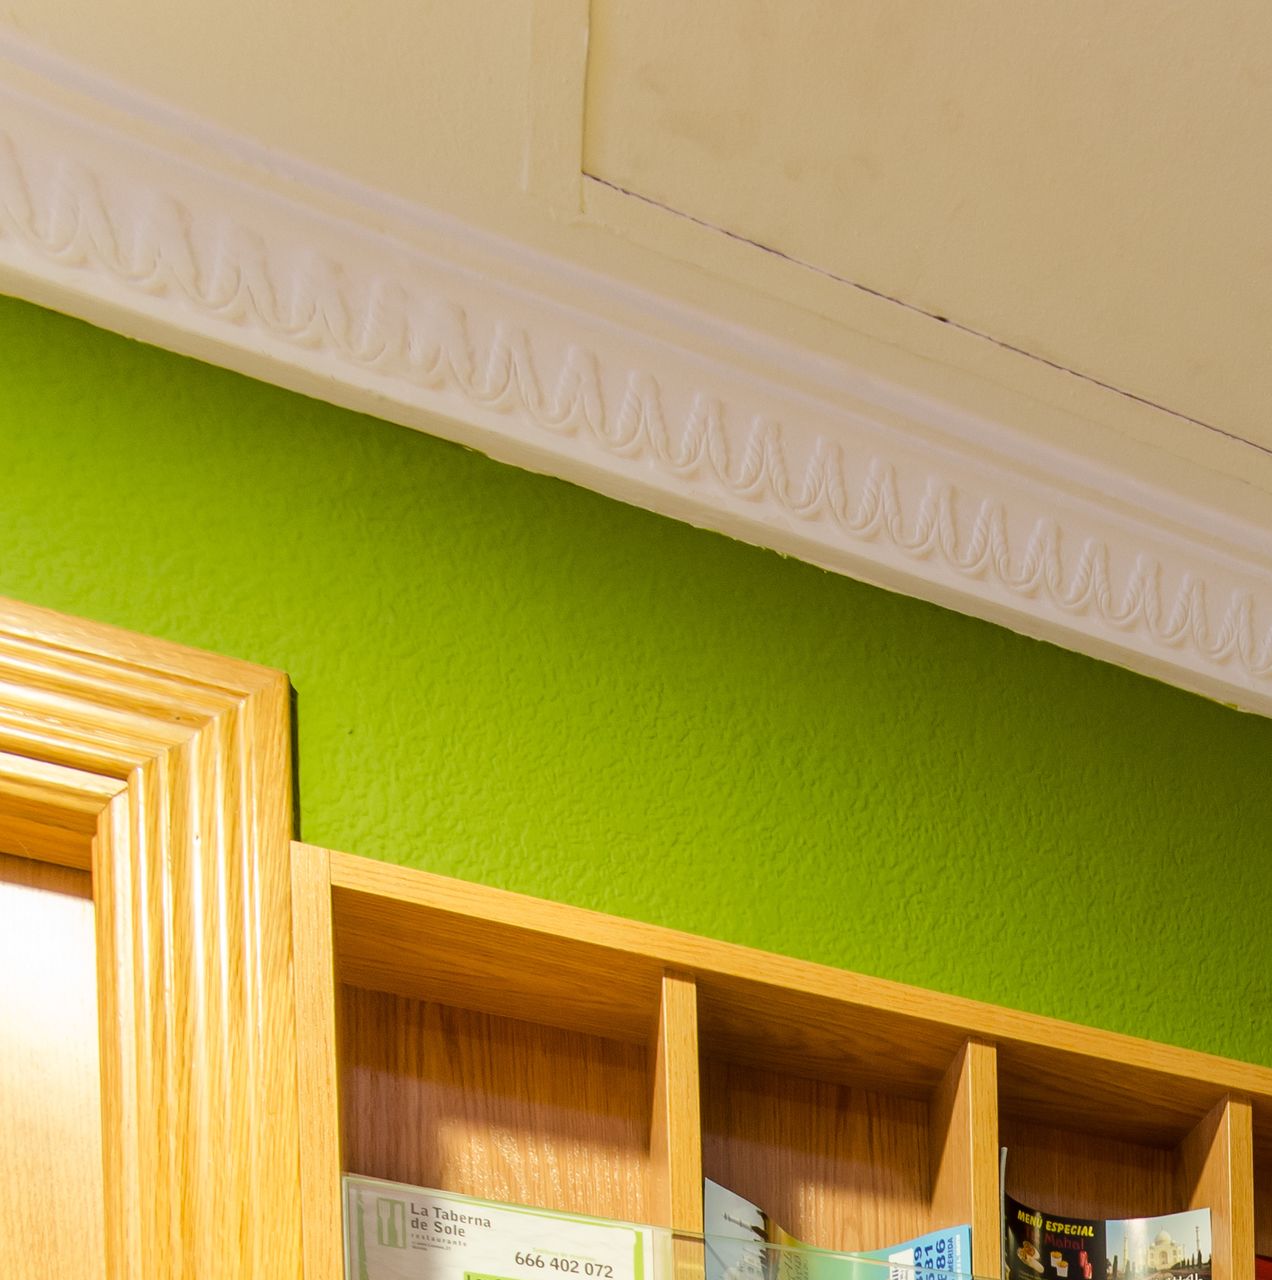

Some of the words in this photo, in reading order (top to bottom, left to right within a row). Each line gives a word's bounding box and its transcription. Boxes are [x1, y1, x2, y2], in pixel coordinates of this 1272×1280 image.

[411, 1203, 428, 1216] La
[432, 1207, 491, 1227] Taberna
[411, 1218, 428, 1230] de
[434, 1221, 465, 1237] Sole
[1045, 1220, 1094, 1237] ESPECIAL
[515, 1252, 545, 1268] 666
[550, 1258, 579, 1273] 402
[585, 1262, 614, 1278] 072
